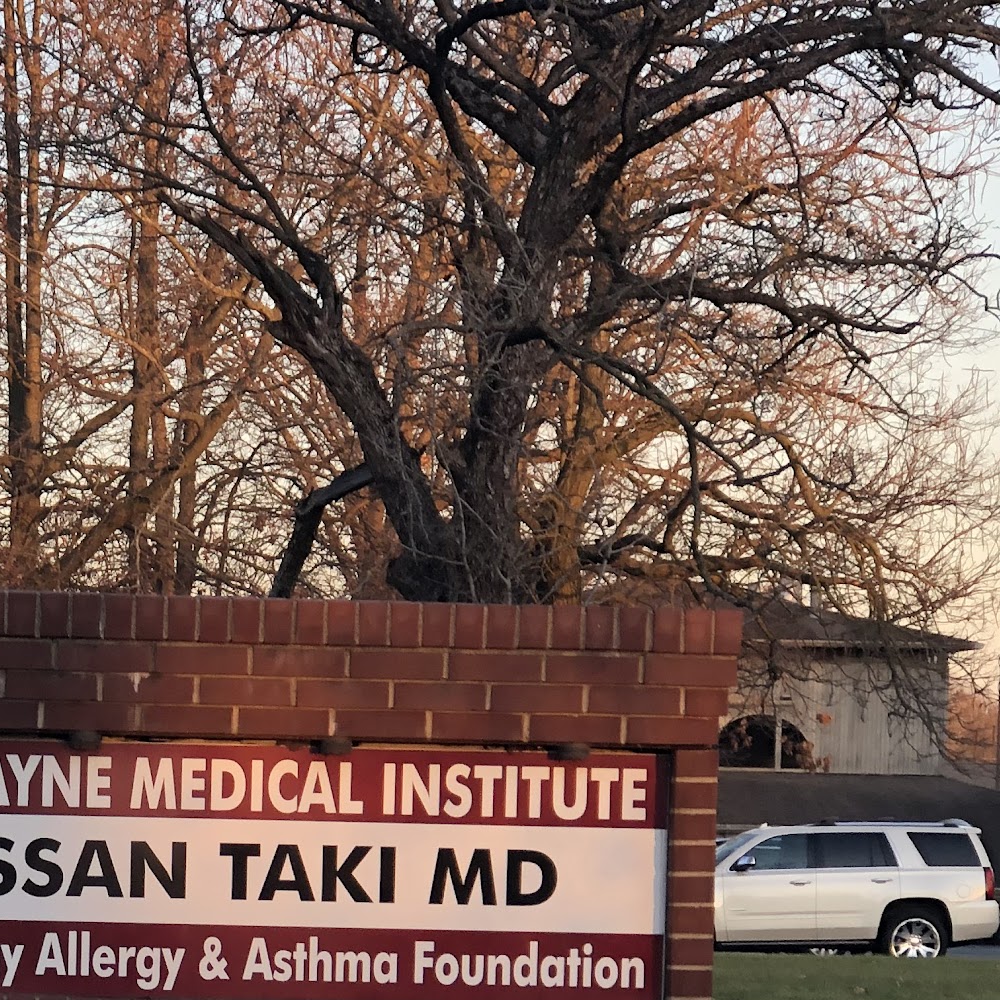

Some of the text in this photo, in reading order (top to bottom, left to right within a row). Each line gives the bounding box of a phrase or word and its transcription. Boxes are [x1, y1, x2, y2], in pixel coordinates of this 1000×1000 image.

[130, 756, 364, 815] MEDICAL
[382, 762, 648, 821] INSTITUTE
[220, 843, 396, 903] TAKI
[428, 848, 558, 907] MD
[35, 931, 186, 991] Allergy
[199, 936, 230, 981] &
[242, 936, 398, 983] Asthma
[414, 941, 645, 990] Foundation
